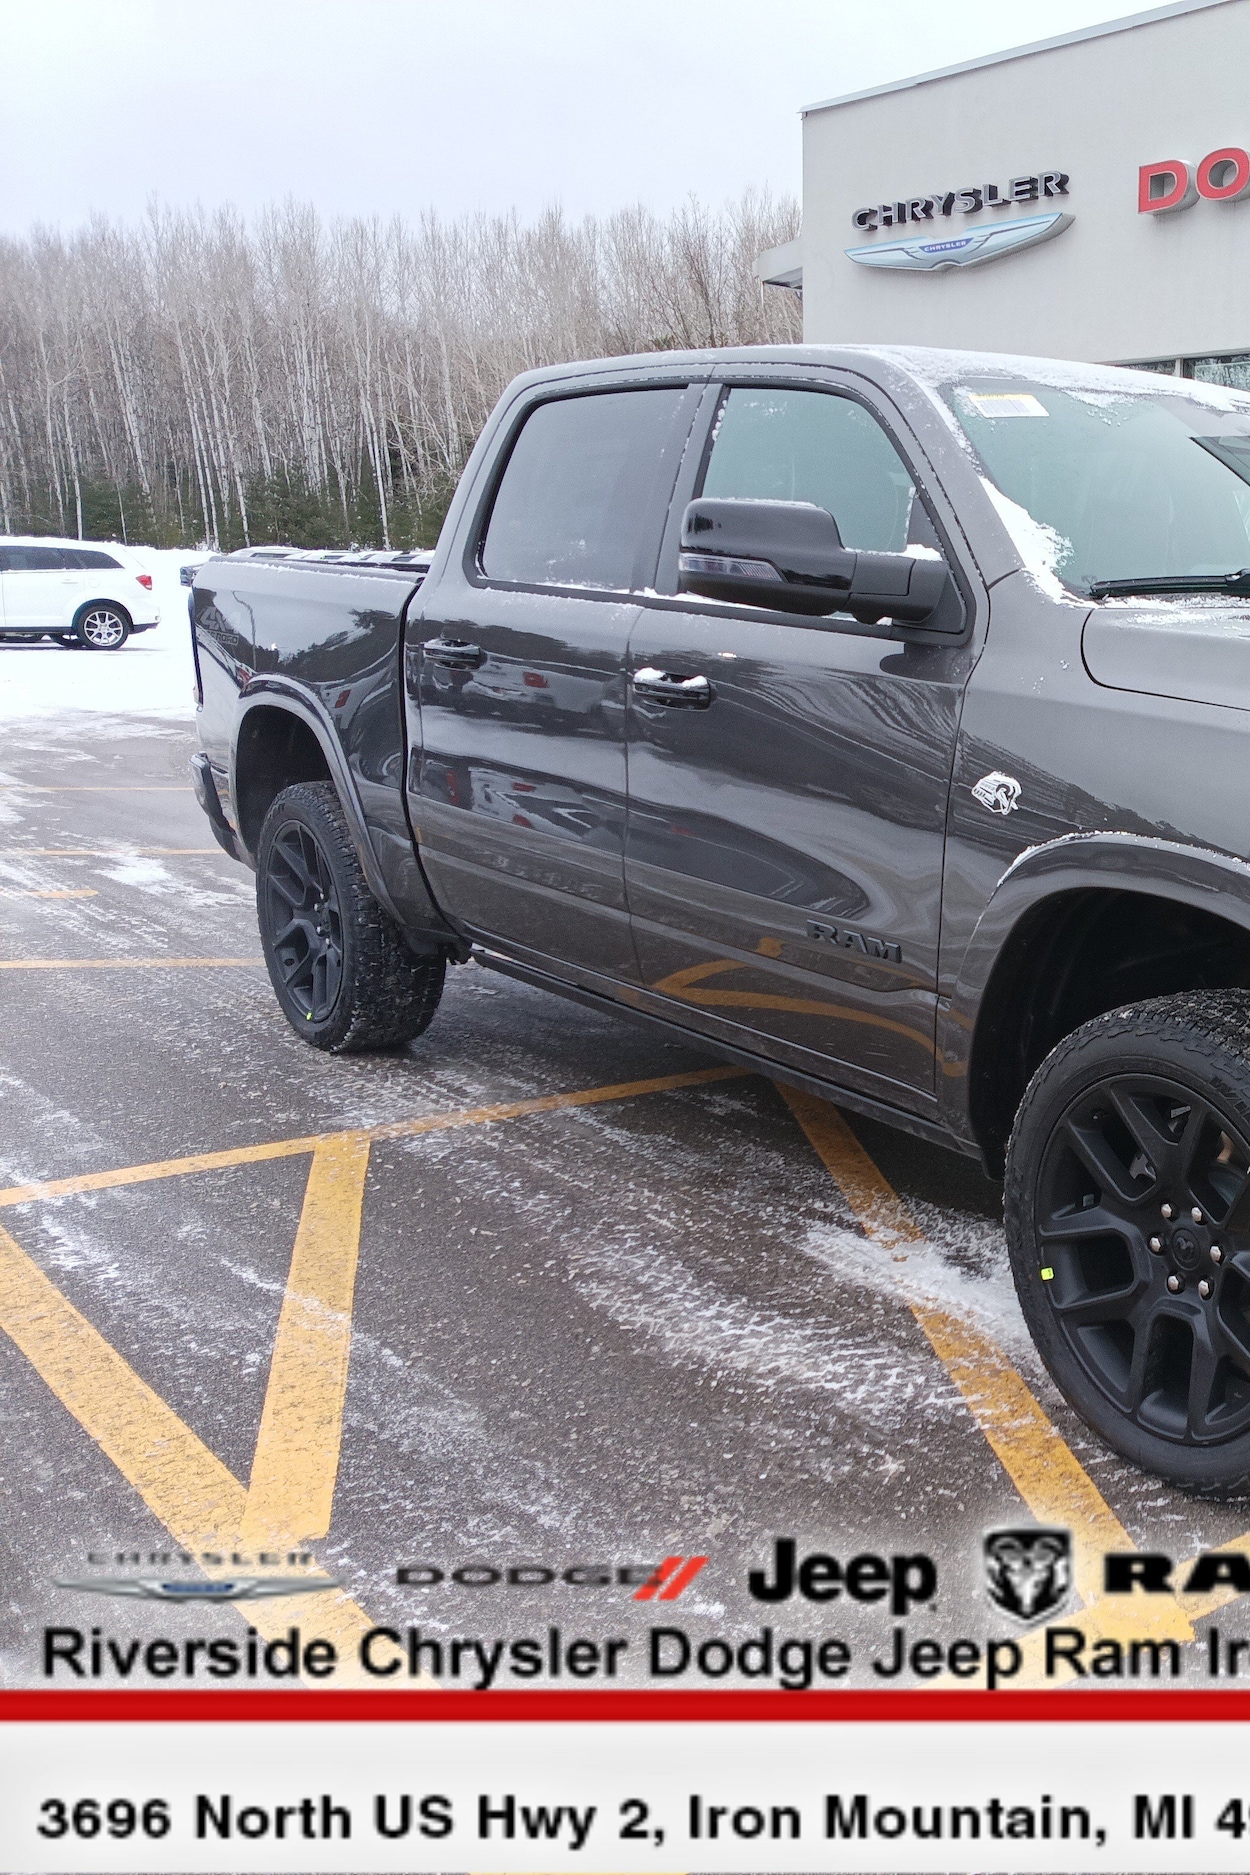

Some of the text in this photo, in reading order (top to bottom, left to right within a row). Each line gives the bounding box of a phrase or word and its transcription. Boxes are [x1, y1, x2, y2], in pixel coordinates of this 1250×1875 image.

[852, 170, 1070, 231] CHRYSLER
[923, 241, 967, 252] CHRYSLER
[806, 918, 903, 964] RAM
